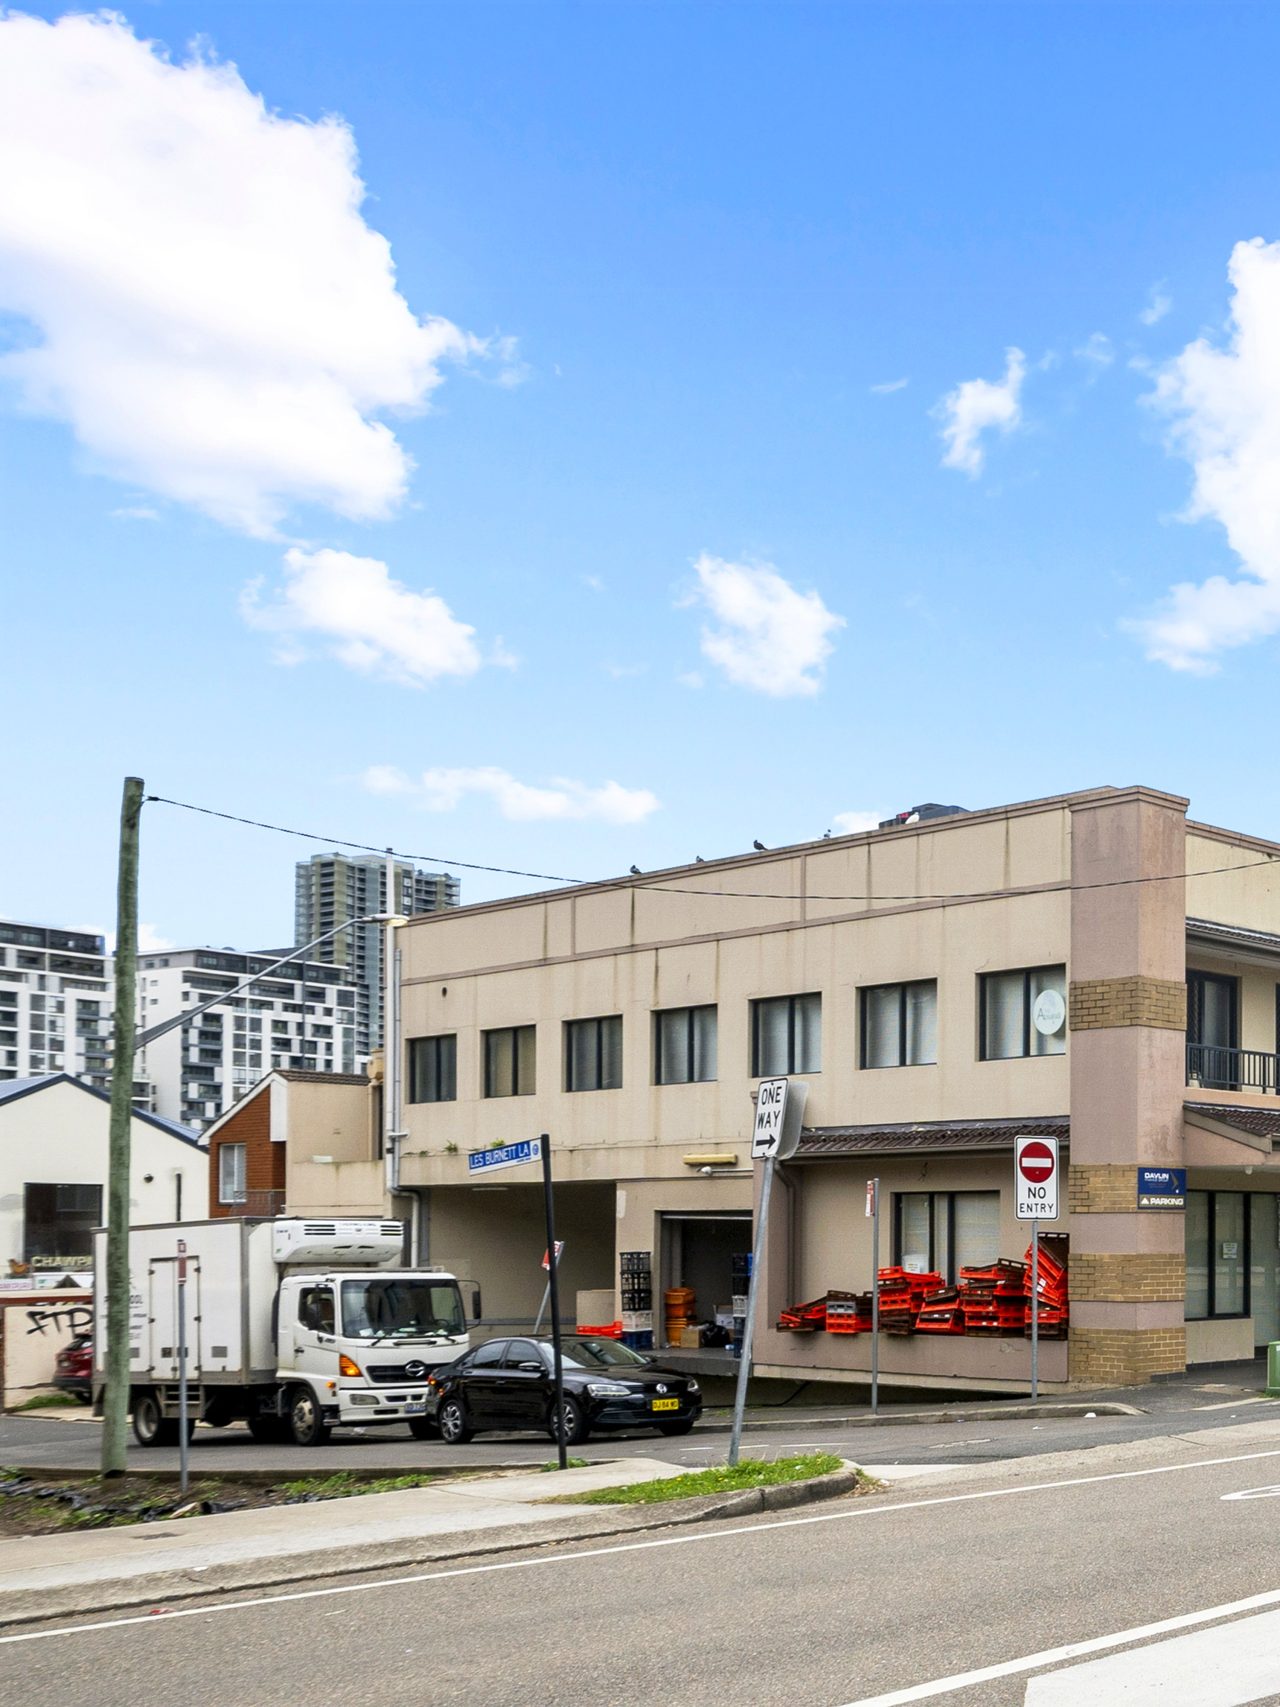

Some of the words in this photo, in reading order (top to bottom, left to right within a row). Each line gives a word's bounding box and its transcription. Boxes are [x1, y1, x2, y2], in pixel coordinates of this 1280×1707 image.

[761, 1086, 782, 1105] ONE
[757, 1110, 781, 1130] WAY
[470, 1154, 484, 1168] LES
[485, 1146, 517, 1165] BURNETT
[518, 1143, 529, 1157] LA
[1027, 1187, 1047, 1199] NO
[1020, 1203, 1054, 1213] ENTRY
[1150, 1197, 1184, 1205] PARKING
